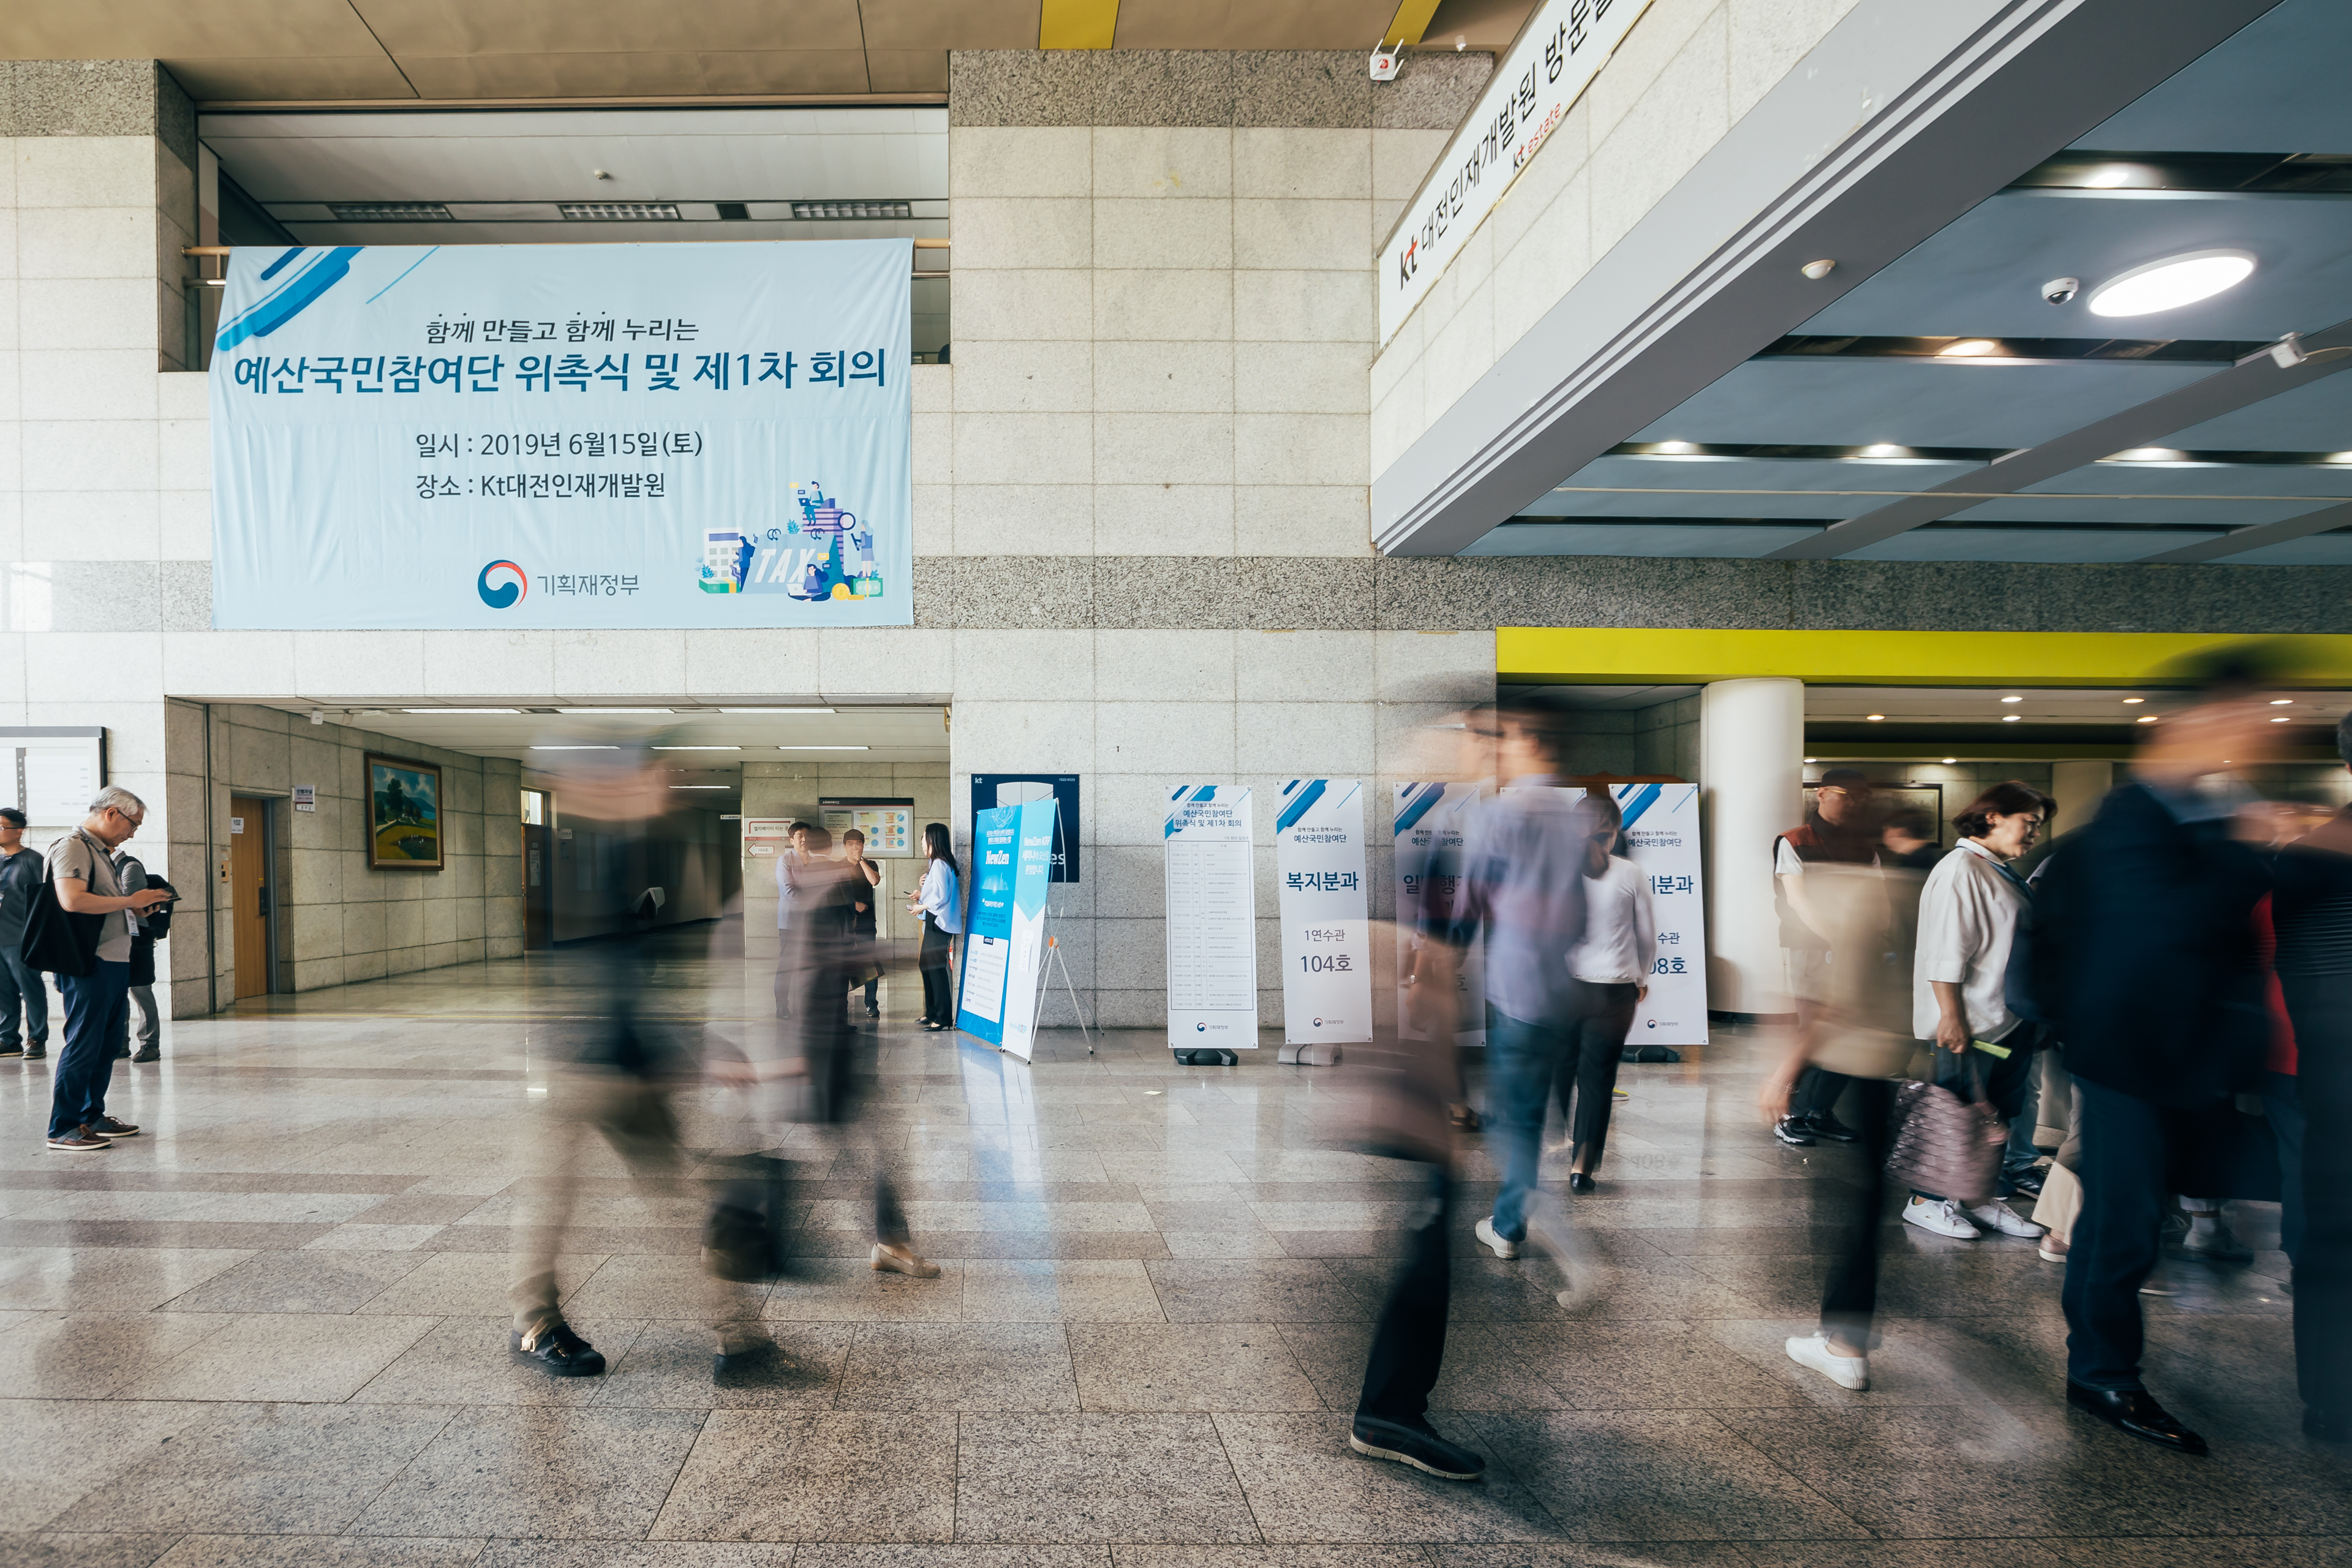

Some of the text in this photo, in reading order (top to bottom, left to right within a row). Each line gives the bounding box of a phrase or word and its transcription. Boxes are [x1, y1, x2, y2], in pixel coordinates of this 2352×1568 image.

[1513, 102, 1561, 174] kt estate
[1401, 235, 1418, 292] kt
[1422, 60, 1537, 251] 대전인재개발원
[427, 317, 699, 344] 함께 만들고 함께 누리는
[234, 347, 885, 394] 예산국민참여단 위촉식 및 제1차 회의
[415, 432, 459, 459] 일시
[480, 432, 562, 458] 2019년
[568, 431, 703, 458] 6월15일(토)
[415, 474, 462, 499] 장소
[481, 472, 666, 499] Kt대전인재개발원
[753, 548, 816, 583] TAX
[537, 574, 639, 597] 기획재정부
[1023, 837, 1041, 846] NewZen
[1294, 834, 1347, 843] 예산국민참여단
[986, 850, 1009, 865] NewZen
[1286, 872, 1359, 891] 복지분과
[1403, 875, 1463, 895] 일행
[1305, 929, 1345, 941] 1연수관
[1300, 954, 1352, 972] 104호
